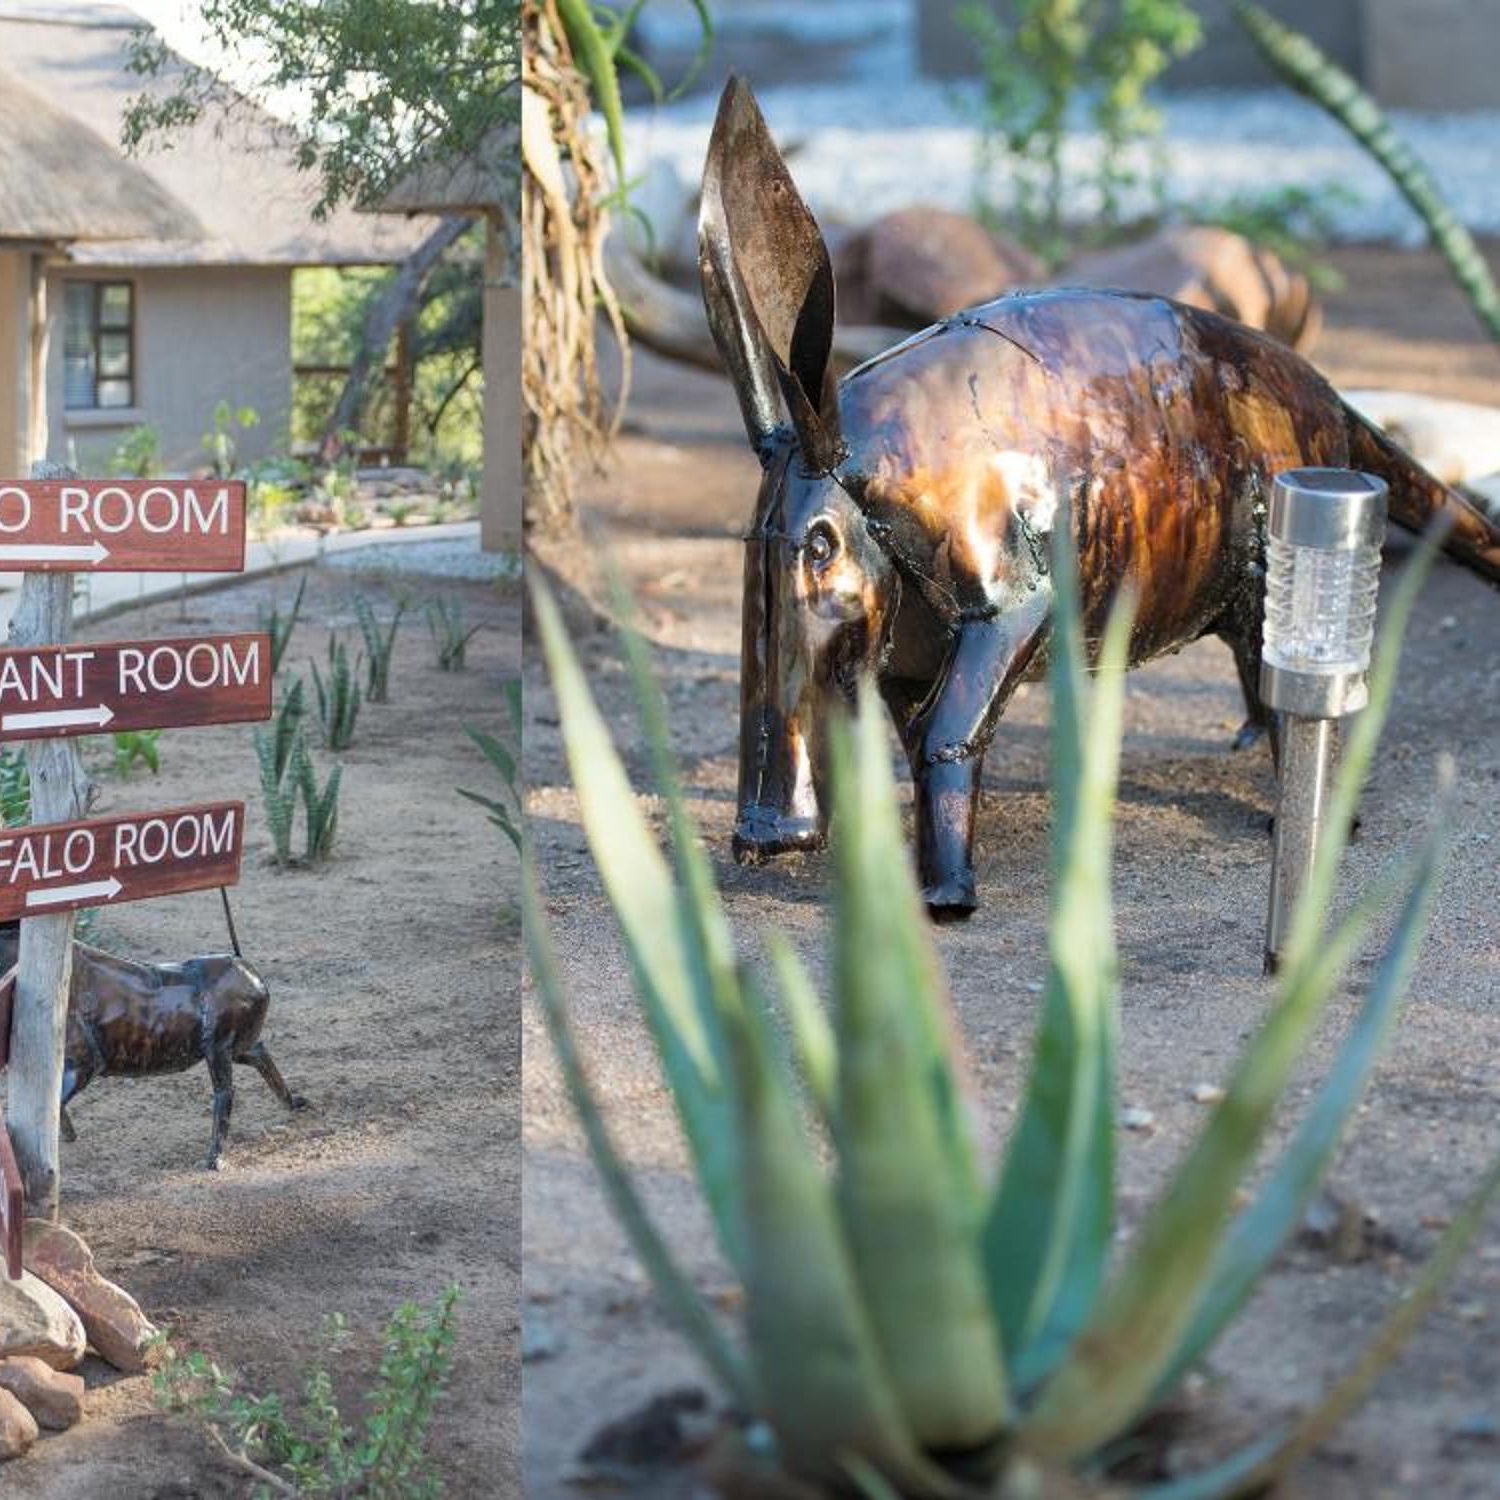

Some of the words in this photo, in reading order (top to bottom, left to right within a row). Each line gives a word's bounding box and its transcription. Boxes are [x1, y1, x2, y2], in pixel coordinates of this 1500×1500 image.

[60, 486, 230, 535] ROOM
[118, 641, 260, 694] ROOM
[114, 811, 235, 867] ROOM
